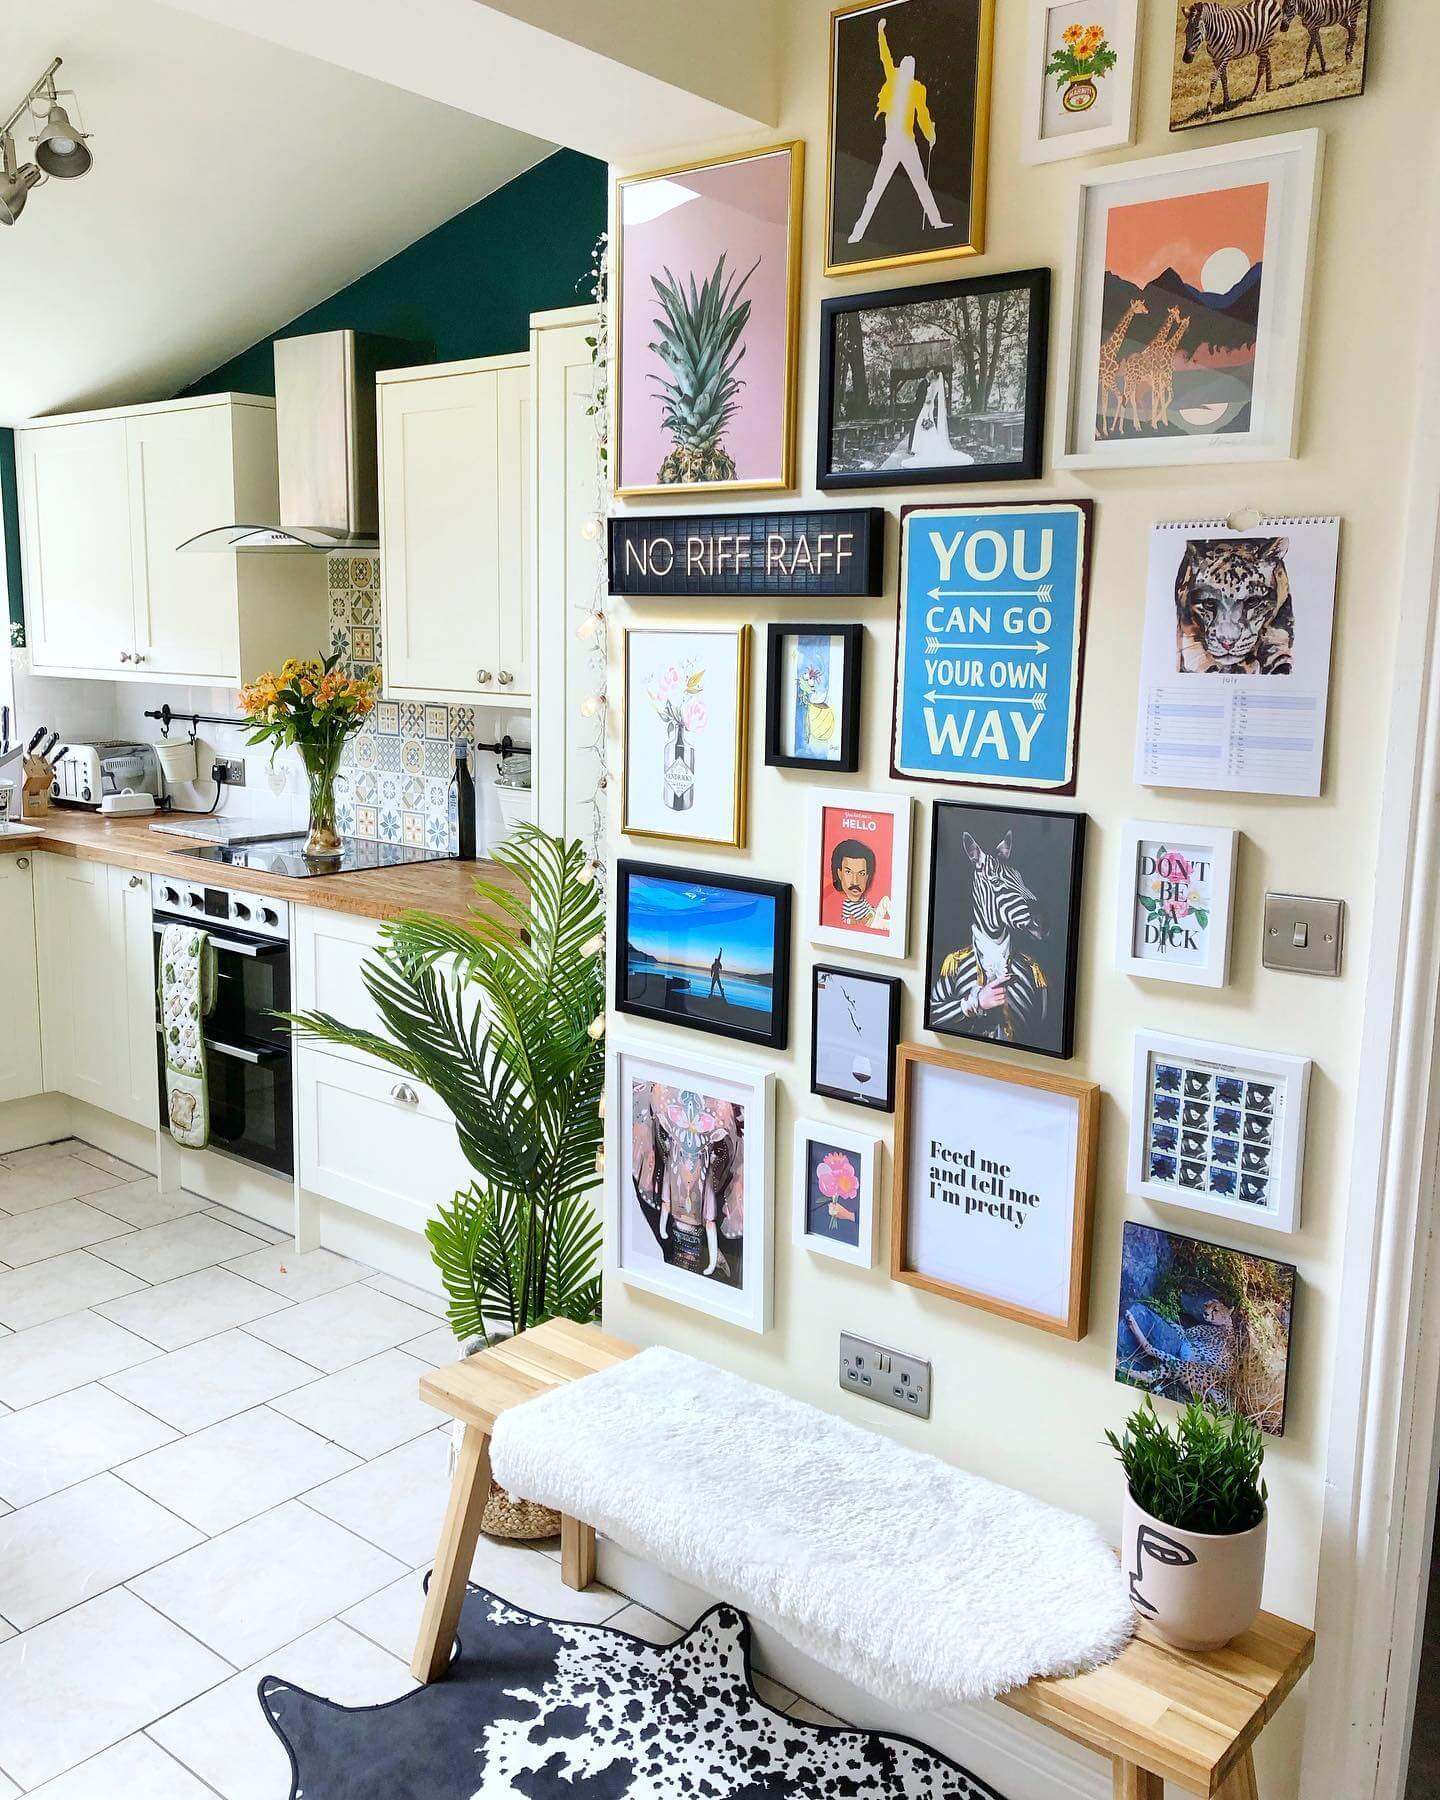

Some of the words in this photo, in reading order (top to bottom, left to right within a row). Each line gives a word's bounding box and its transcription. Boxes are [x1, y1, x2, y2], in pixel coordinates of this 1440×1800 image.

[625, 537, 674, 577] NO
[687, 535, 751, 577] RIFF
[767, 533, 854, 576] RAFF
[928, 528, 1054, 582] YOU
[925, 606, 991, 634] CAN
[1003, 607, 1052, 635] GO
[924, 659, 985, 687] YOUR
[989, 661, 1048, 689] OWN
[922, 706, 1045, 762] WAY
[842, 818, 876, 831] HELLO
[1141, 855, 1211, 882] DON'T
[1159, 880, 1189, 903] BE
[1164, 904, 1179, 925] A
[1144, 924, 1199, 951] DICK
[930, 1140, 976, 1169] Feed
[981, 1158, 1011, 1178] me
[929, 1166, 966, 1187] and
[971, 1174, 1004, 1198] tell
[1009, 1188, 1041, 1208] me
[930, 1181, 960, 1206] I'm
[965, 1196, 1027, 1229] pretty
